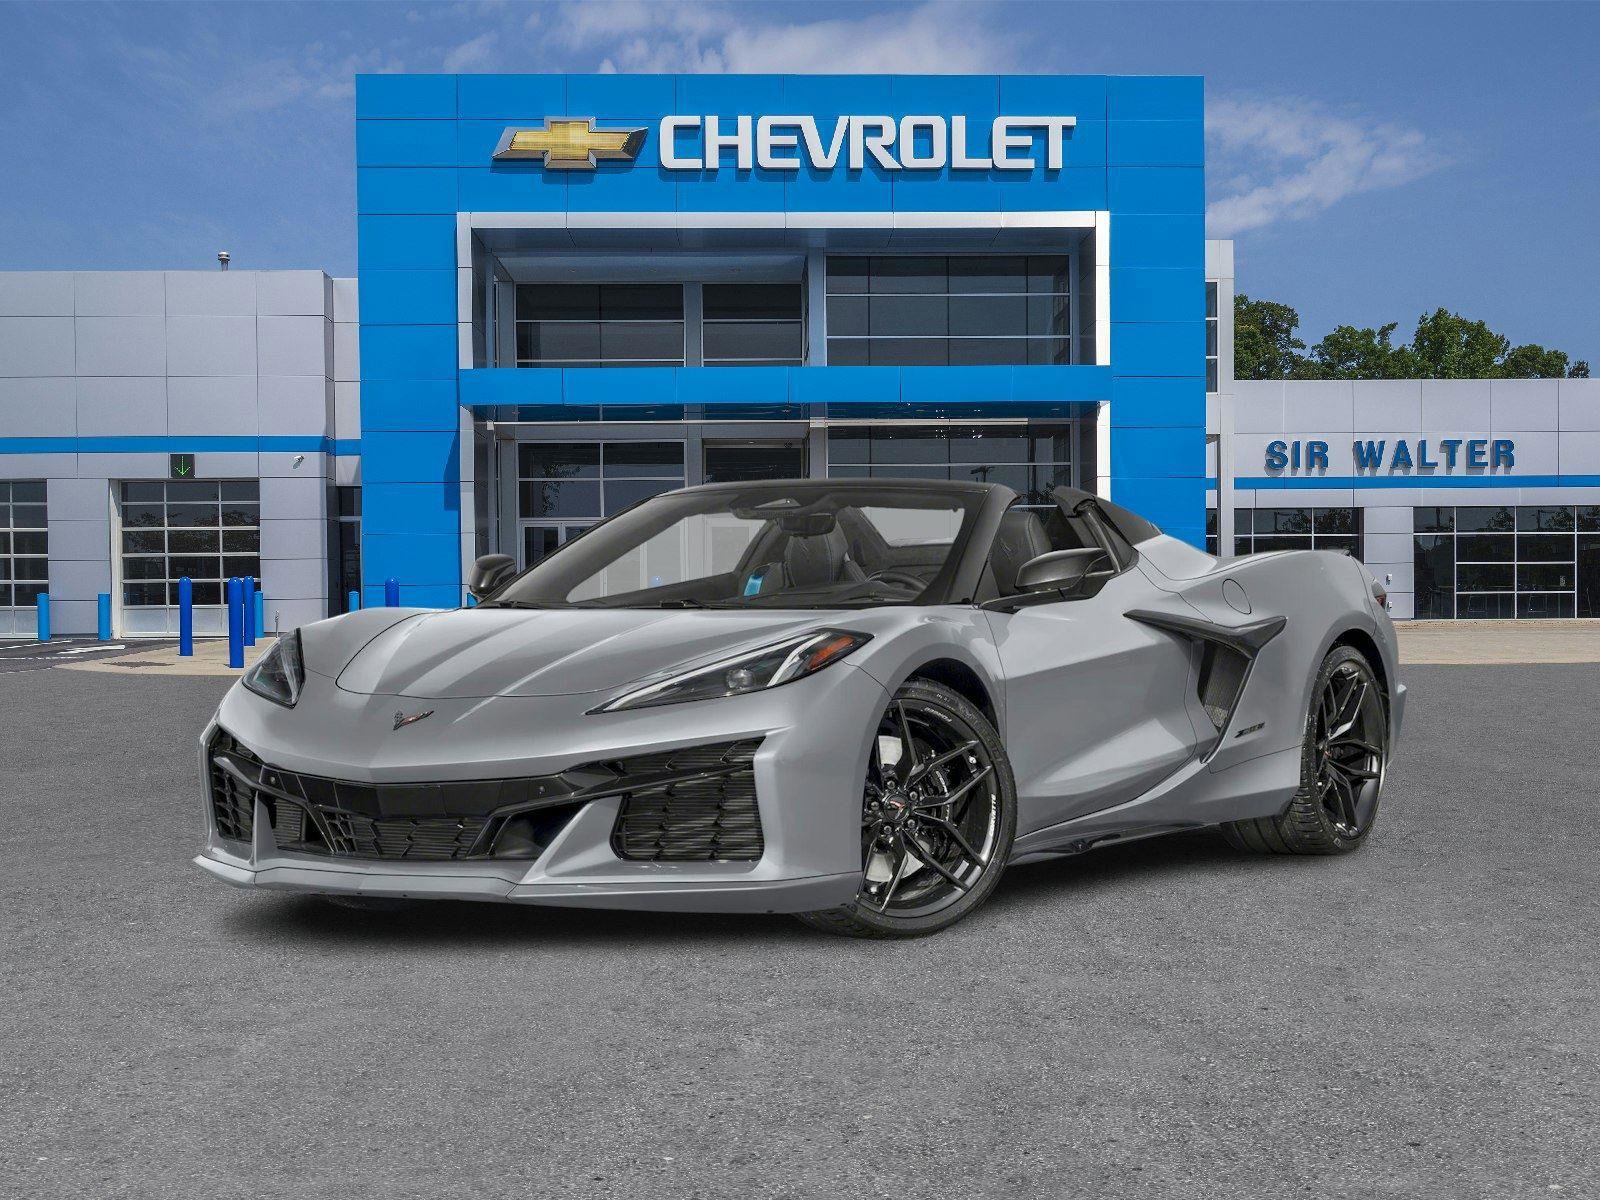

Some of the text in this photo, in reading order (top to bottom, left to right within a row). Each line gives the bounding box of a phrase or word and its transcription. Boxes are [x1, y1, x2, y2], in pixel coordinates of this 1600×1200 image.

[659, 115, 1077, 169] CHEVROLET
[1265, 439, 1516, 470] SIR WALTER
